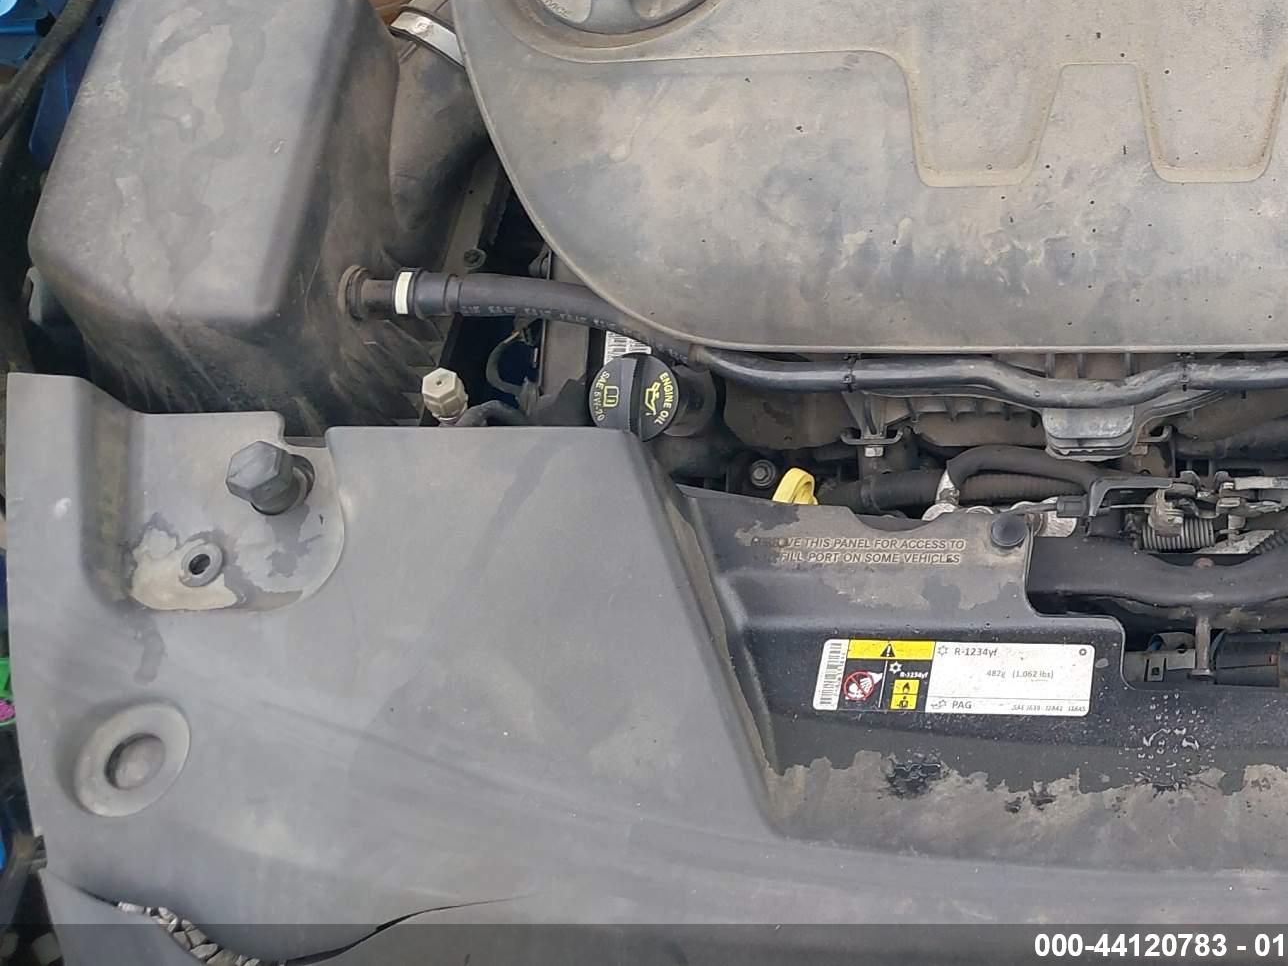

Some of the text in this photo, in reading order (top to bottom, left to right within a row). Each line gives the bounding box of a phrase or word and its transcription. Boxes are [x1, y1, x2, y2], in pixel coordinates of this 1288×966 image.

[596, 371, 610, 390] SAE
[654, 372, 674, 425] ENGINE OIL
[805, 537, 830, 548] THIS
[834, 538, 870, 549] PANEL
[874, 539, 897, 549] FOR
[900, 539, 946, 549] ACCESS
[950, 540, 965, 550] TO
[808, 552, 839, 563] PORT
[843, 552, 861, 563] ON
[865, 552, 899, 563] SOME
[903, 553, 960, 564] VEHICLES
[954, 647, 998, 659] R-1234yf
[952, 700, 972, 710] PAG
